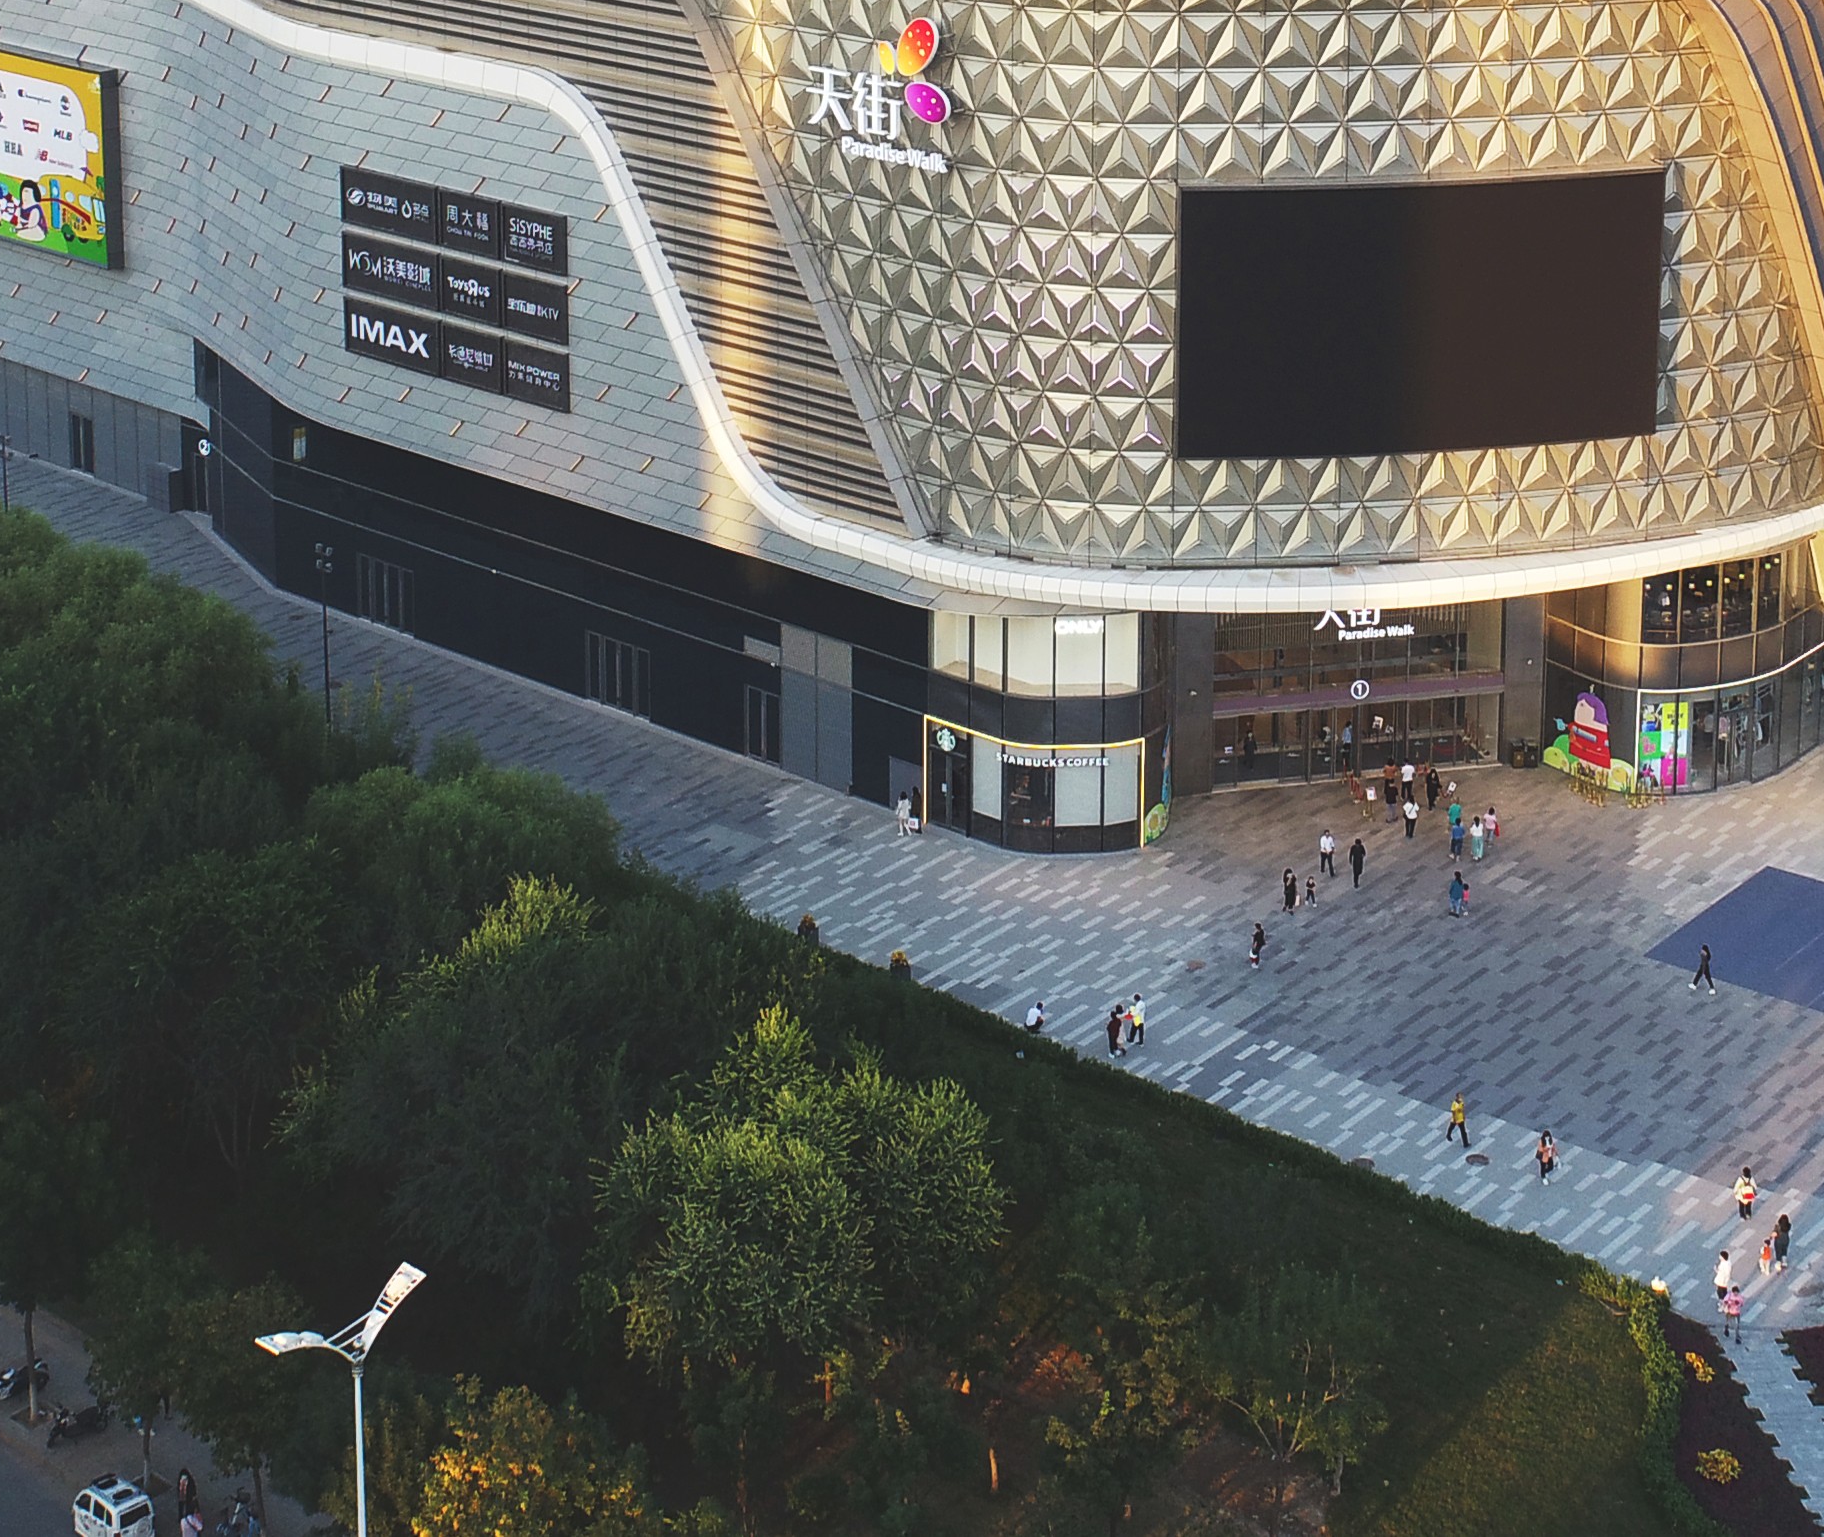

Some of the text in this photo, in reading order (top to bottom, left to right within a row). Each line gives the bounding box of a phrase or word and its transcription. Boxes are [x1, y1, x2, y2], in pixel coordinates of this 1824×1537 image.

[806, 65, 905, 140] 天街
[53, 128, 72, 141] MLB
[841, 135, 949, 174] Paradise Walk
[383, 256, 431, 285] 沃美影城
[351, 313, 430, 359] IMAX
[1338, 624, 1415, 641] Paradise Walk
[996, 752, 1110, 767] STARBUCKS COFFEE
